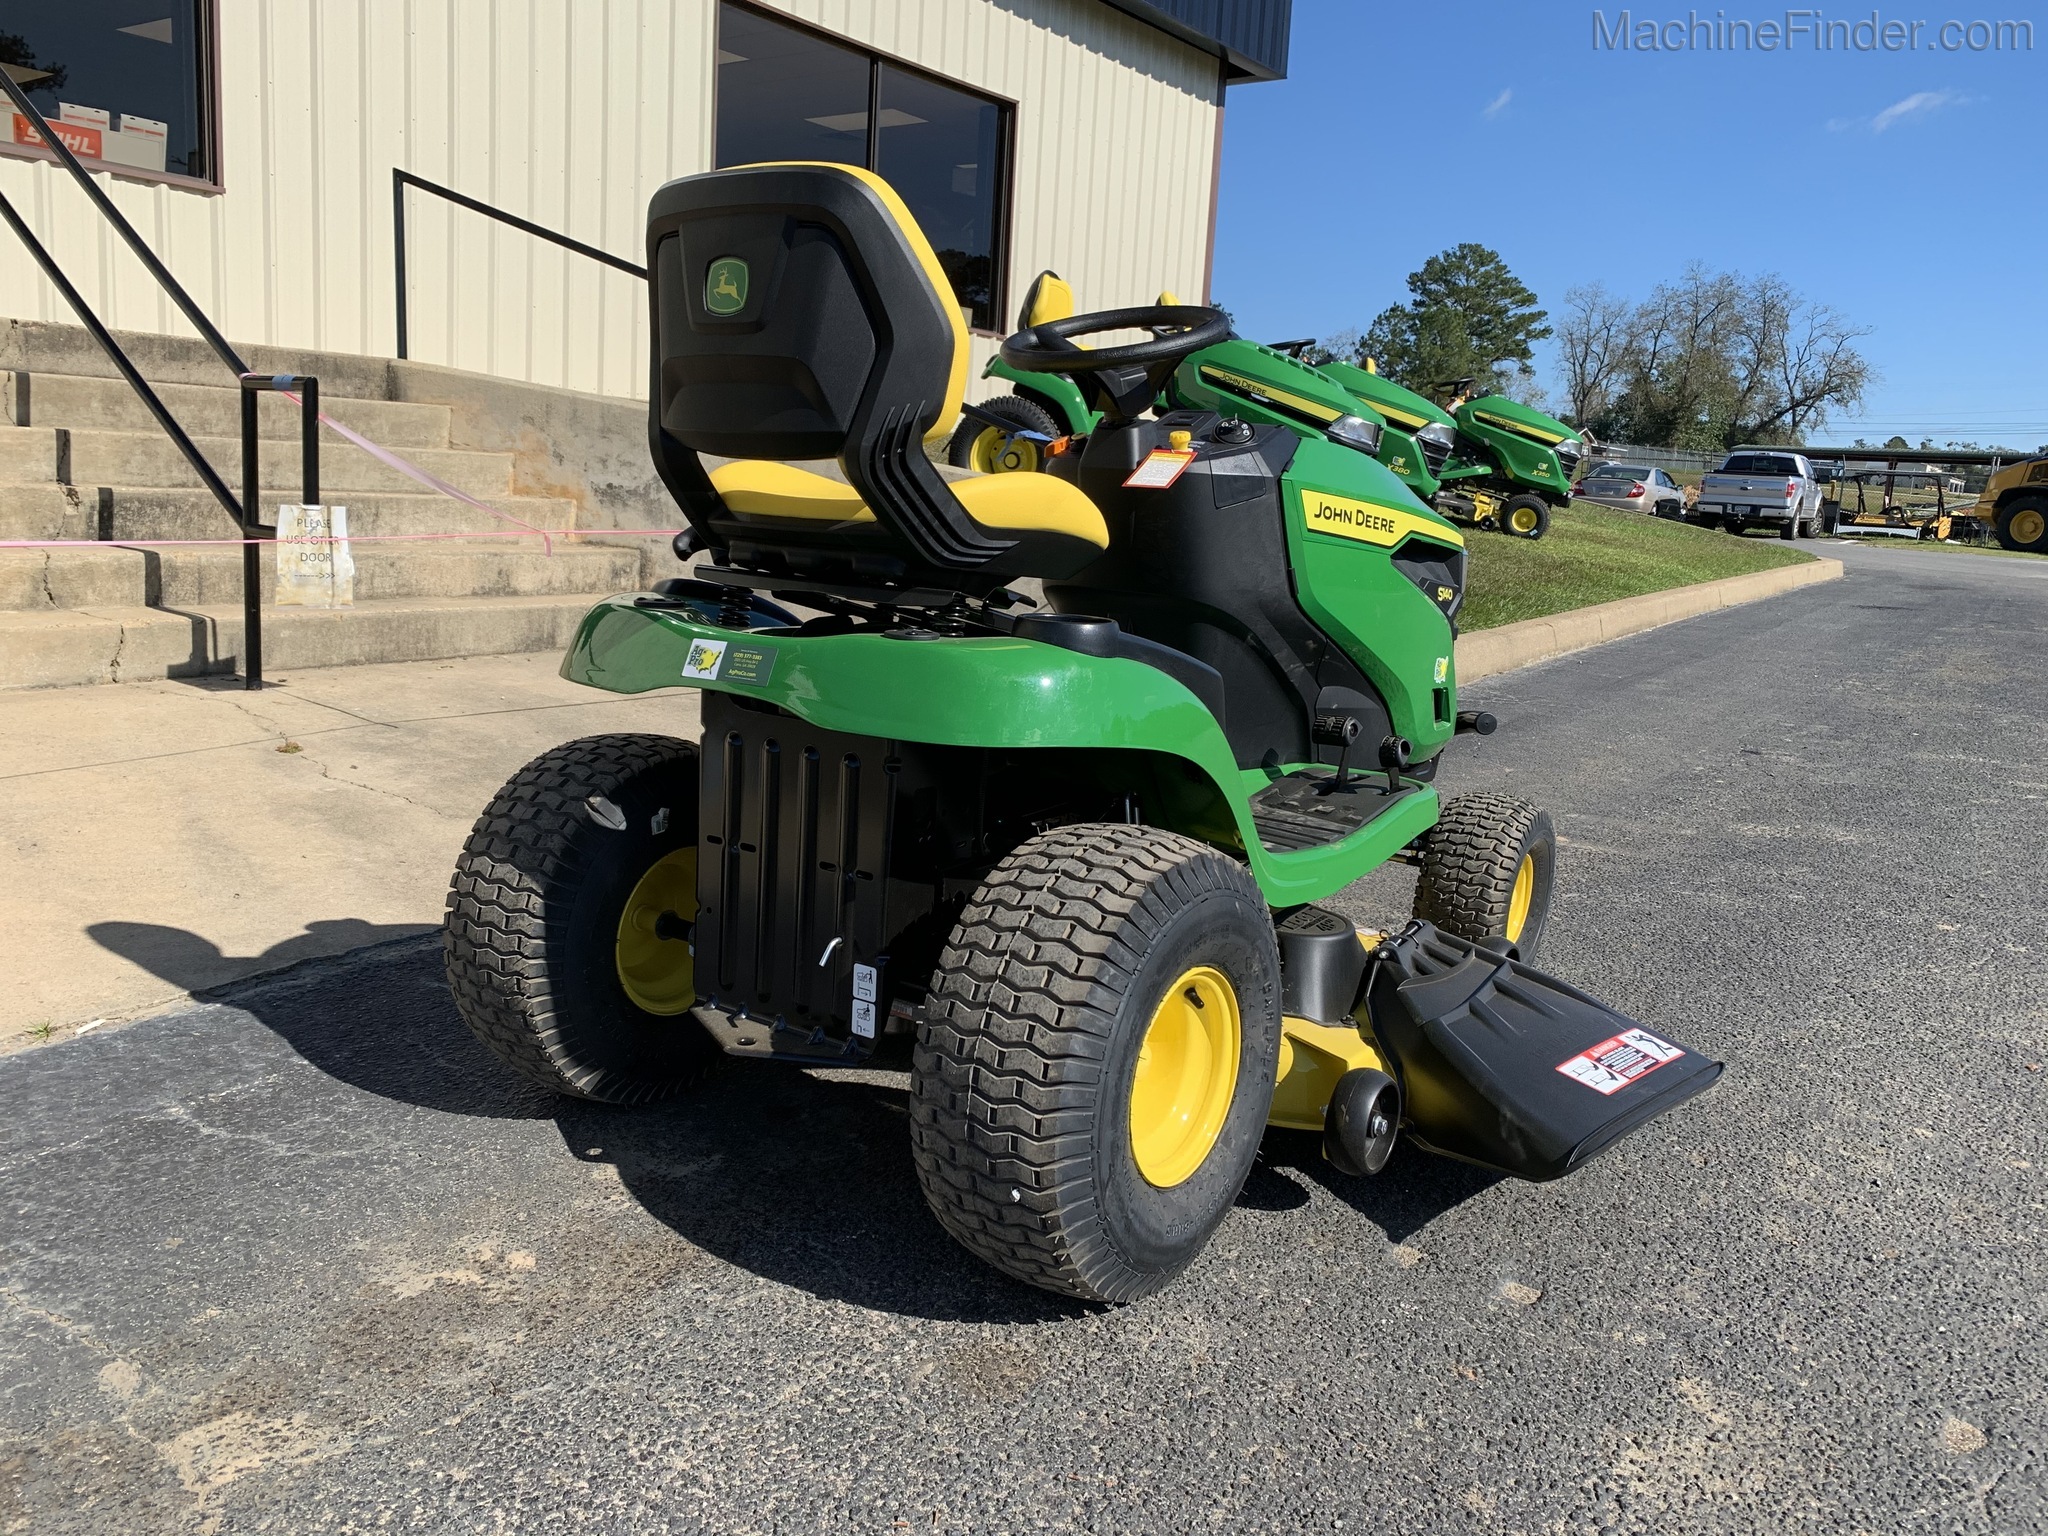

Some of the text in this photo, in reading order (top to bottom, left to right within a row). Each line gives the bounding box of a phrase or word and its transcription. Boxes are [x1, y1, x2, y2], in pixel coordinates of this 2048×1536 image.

[24, 126, 96, 155] SIHL
[1219, 372, 1267, 396] JOHN DEERE
[296, 518, 331, 529] PLEASE
[1313, 501, 1396, 534] JOHN DEERE
[286, 534, 307, 545] USE
[300, 552, 332, 563] DOOR
